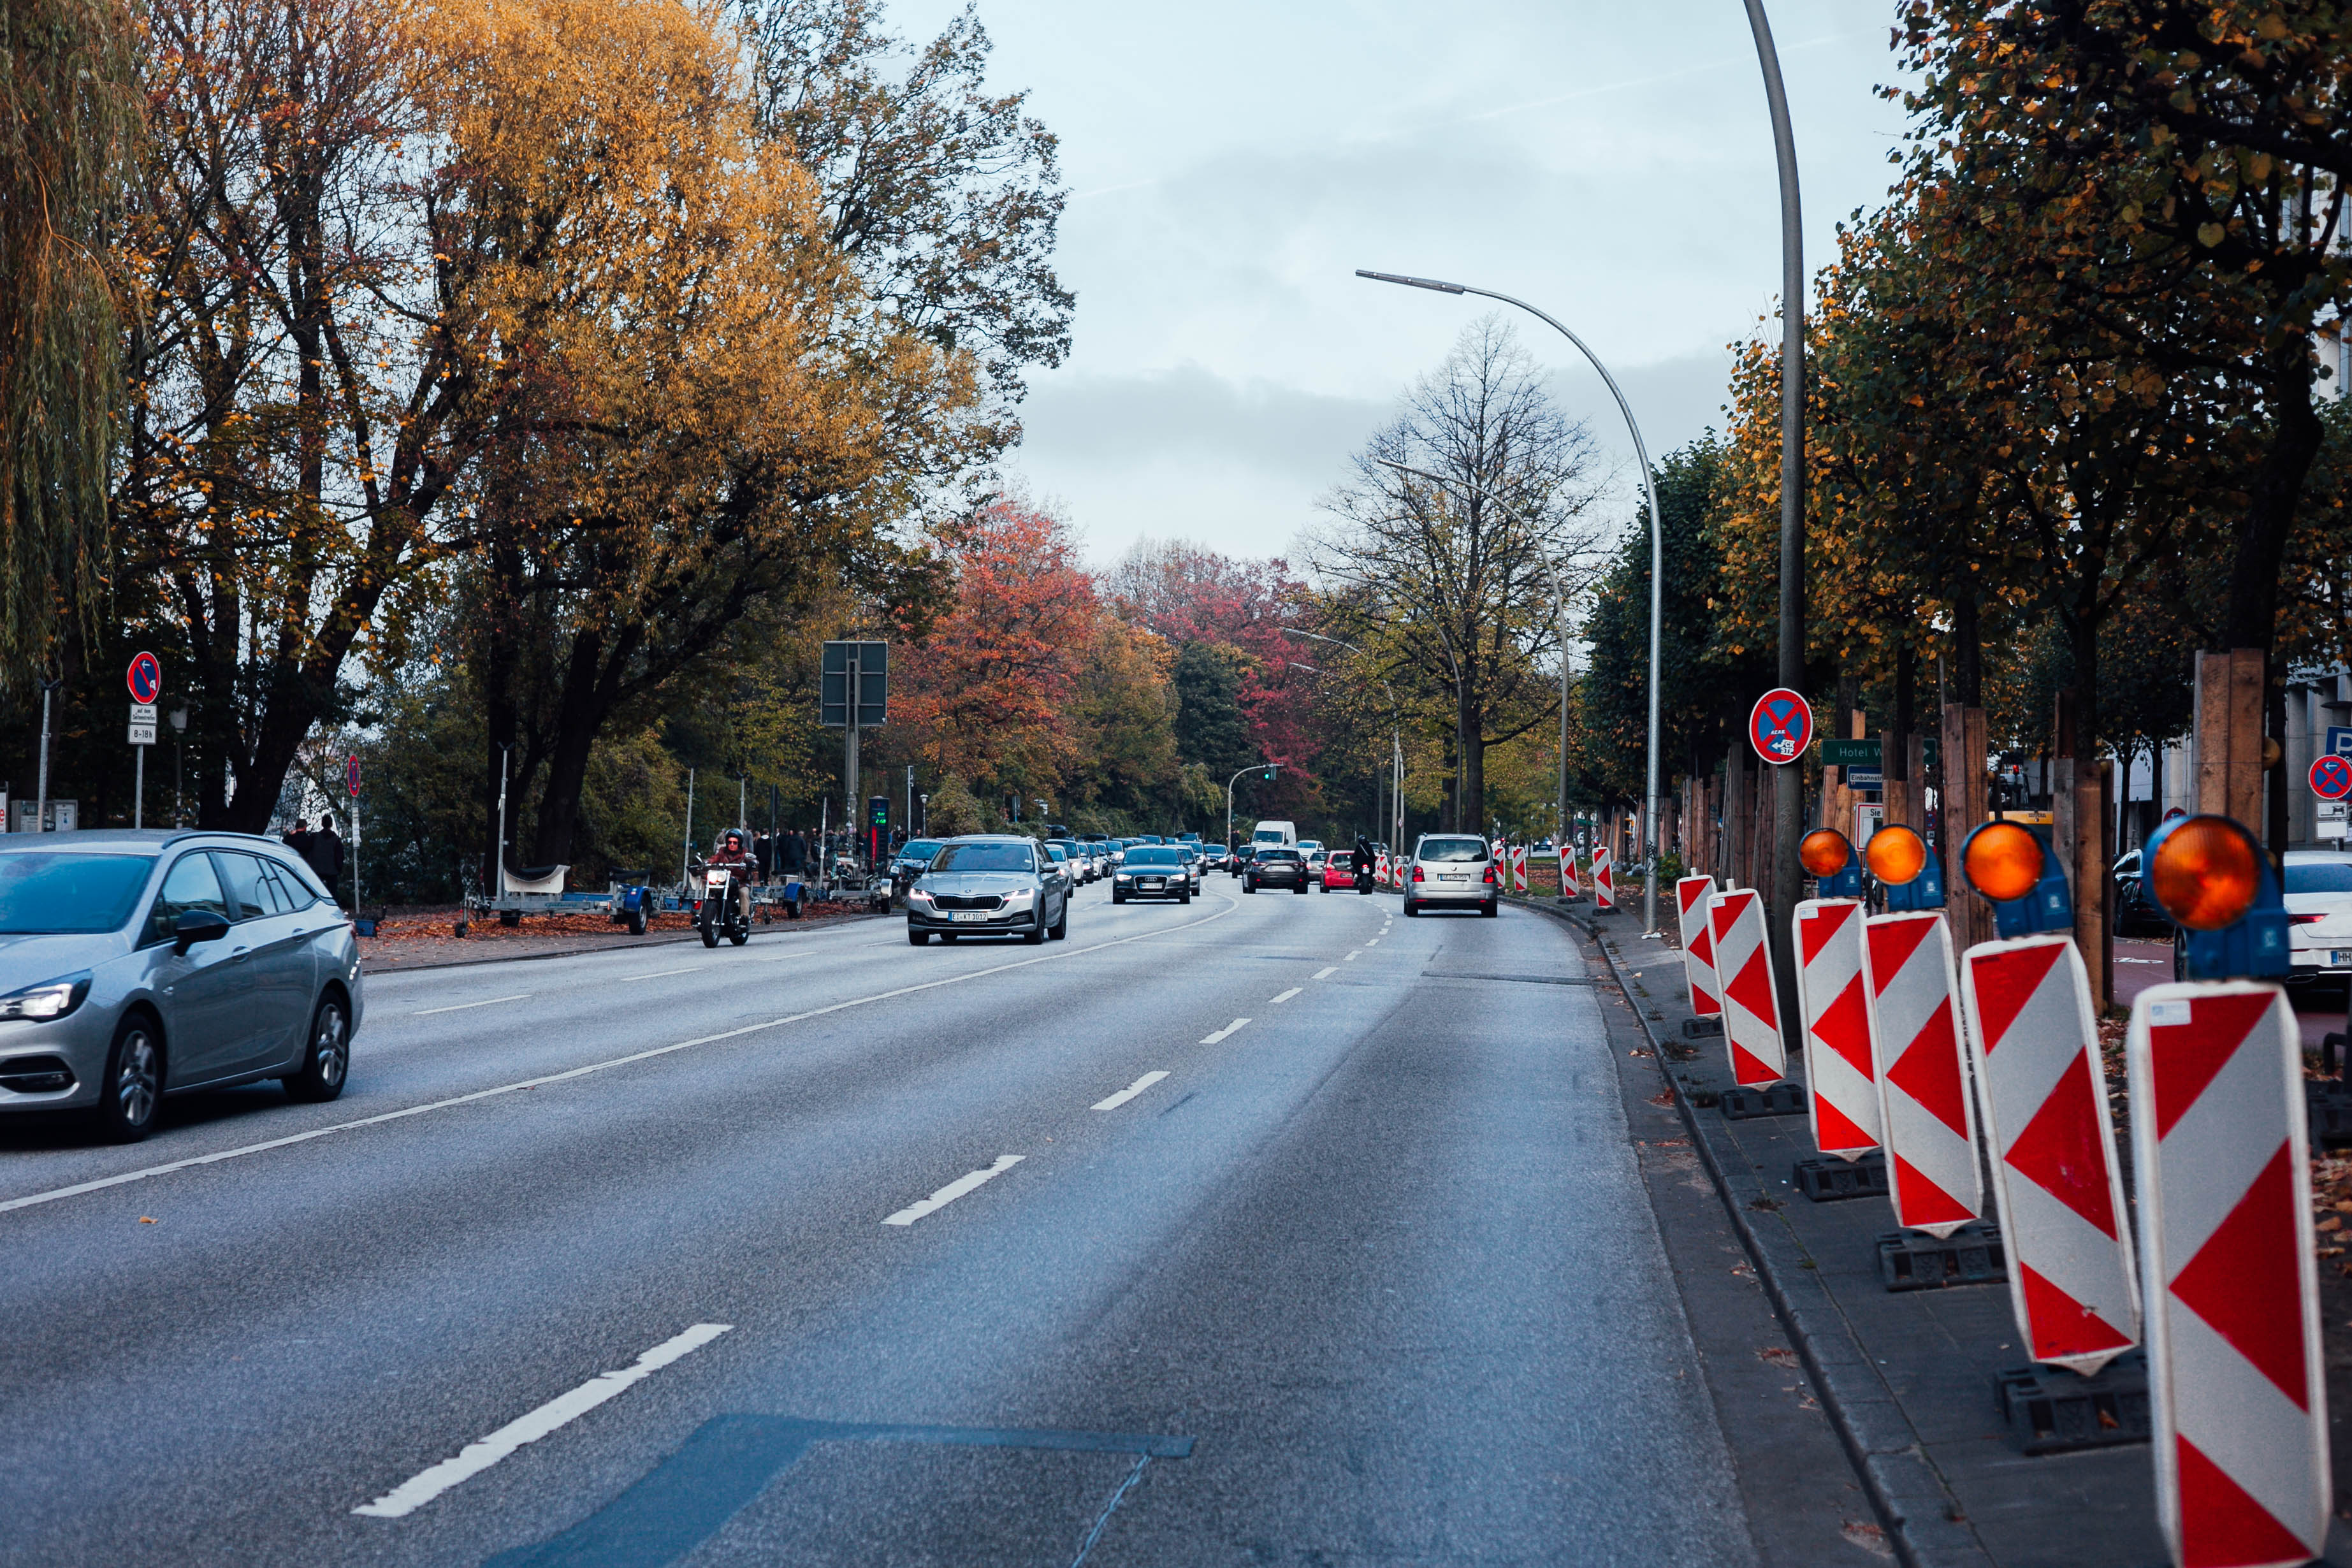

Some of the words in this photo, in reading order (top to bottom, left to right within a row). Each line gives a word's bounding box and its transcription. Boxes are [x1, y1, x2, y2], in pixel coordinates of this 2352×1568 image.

[1840, 747, 1868, 757] Hotel
[1873, 747, 1882, 757] W
[1870, 808, 1881, 817] Sie
[2338, 953, 2351, 962] HH
